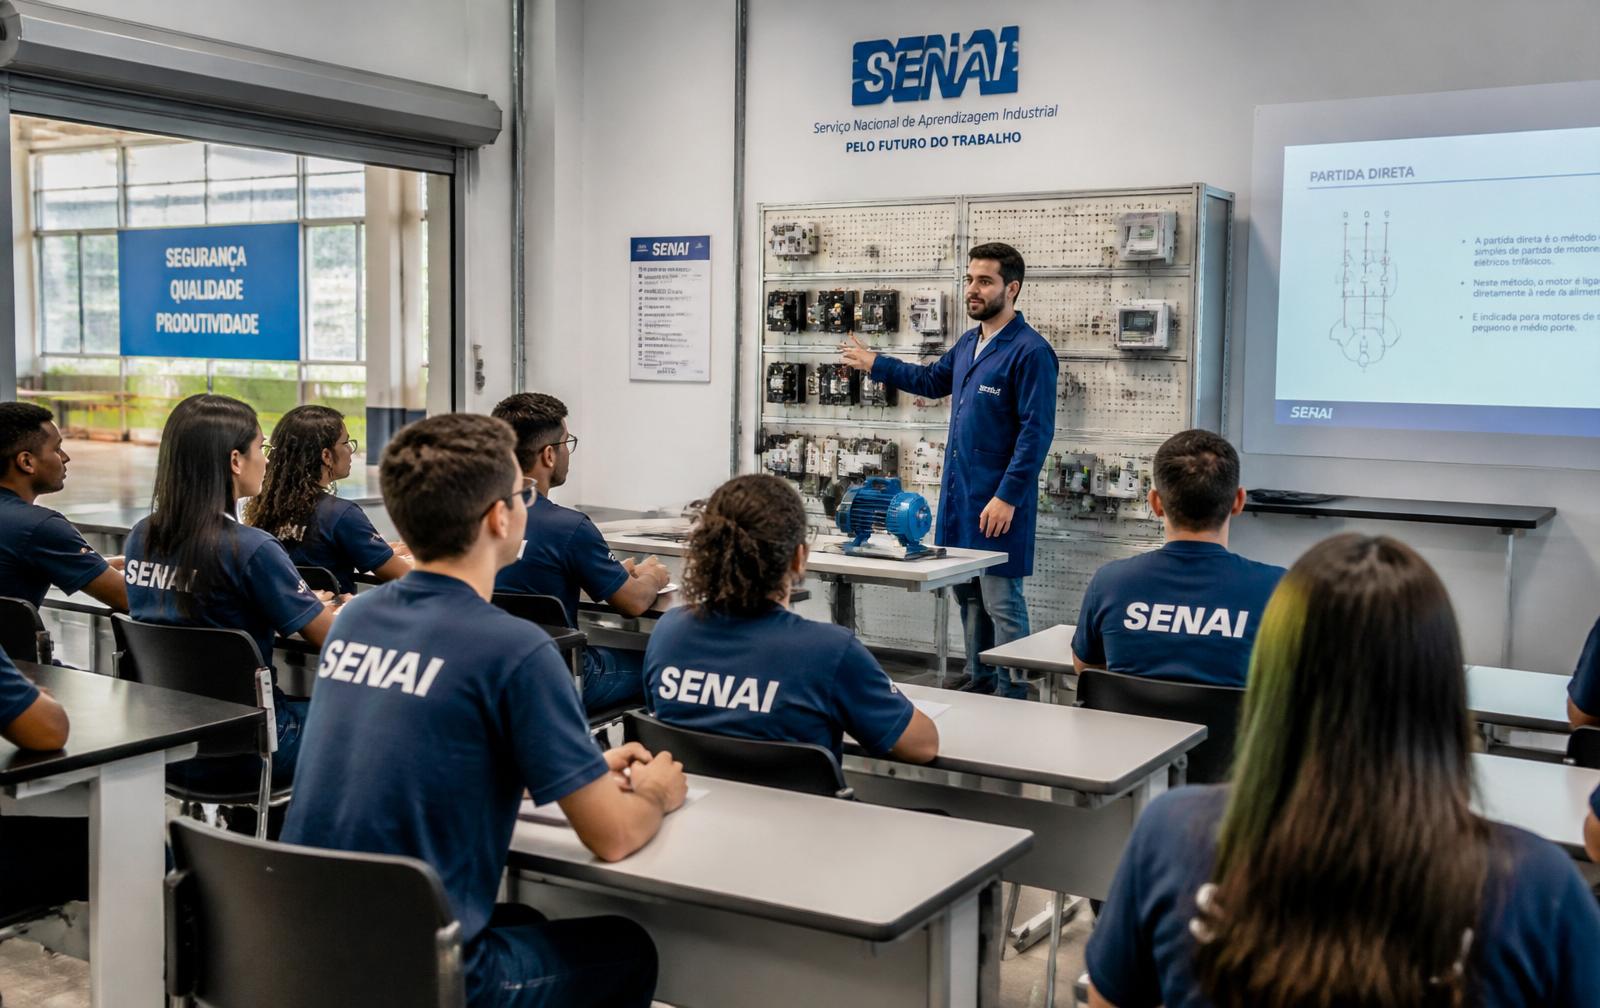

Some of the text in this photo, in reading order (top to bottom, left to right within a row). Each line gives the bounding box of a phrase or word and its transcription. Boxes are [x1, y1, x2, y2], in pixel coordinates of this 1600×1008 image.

[862, 40, 1011, 94] SENAI
[813, 104, 1059, 135] Serviço Nacional de Aprendizagem Industrial
[846, 131, 1022, 153] PELO FUTURO DO TRABALHO
[1310, 166, 1415, 182] PARTIDA DIRETA
[652, 242, 690, 256] SENAI
[1475, 237, 1481, 245] A
[1483, 235, 1514, 247] partida
[1516, 235, 1542, 245] direta
[1561, 232, 1597, 243] método
[1509, 246, 1519, 255] de
[1554, 245, 1565, 254] de
[166, 246, 247, 272] SEGURANÇA
[170, 279, 244, 304] QUALIDADE
[1535, 287, 1556, 296] rede
[1545, 277, 1572, 286] motor
[1582, 276, 1600, 287] liga
[156, 312, 259, 335] PRODUTIVIDADE
[1542, 313, 1580, 321] motores
[1583, 311, 1595, 321] de
[1290, 406, 1333, 419] SENAI
[1123, 602, 1249, 638] SENAI
[318, 639, 445, 697] SENAI
[659, 666, 779, 713] SENAI
